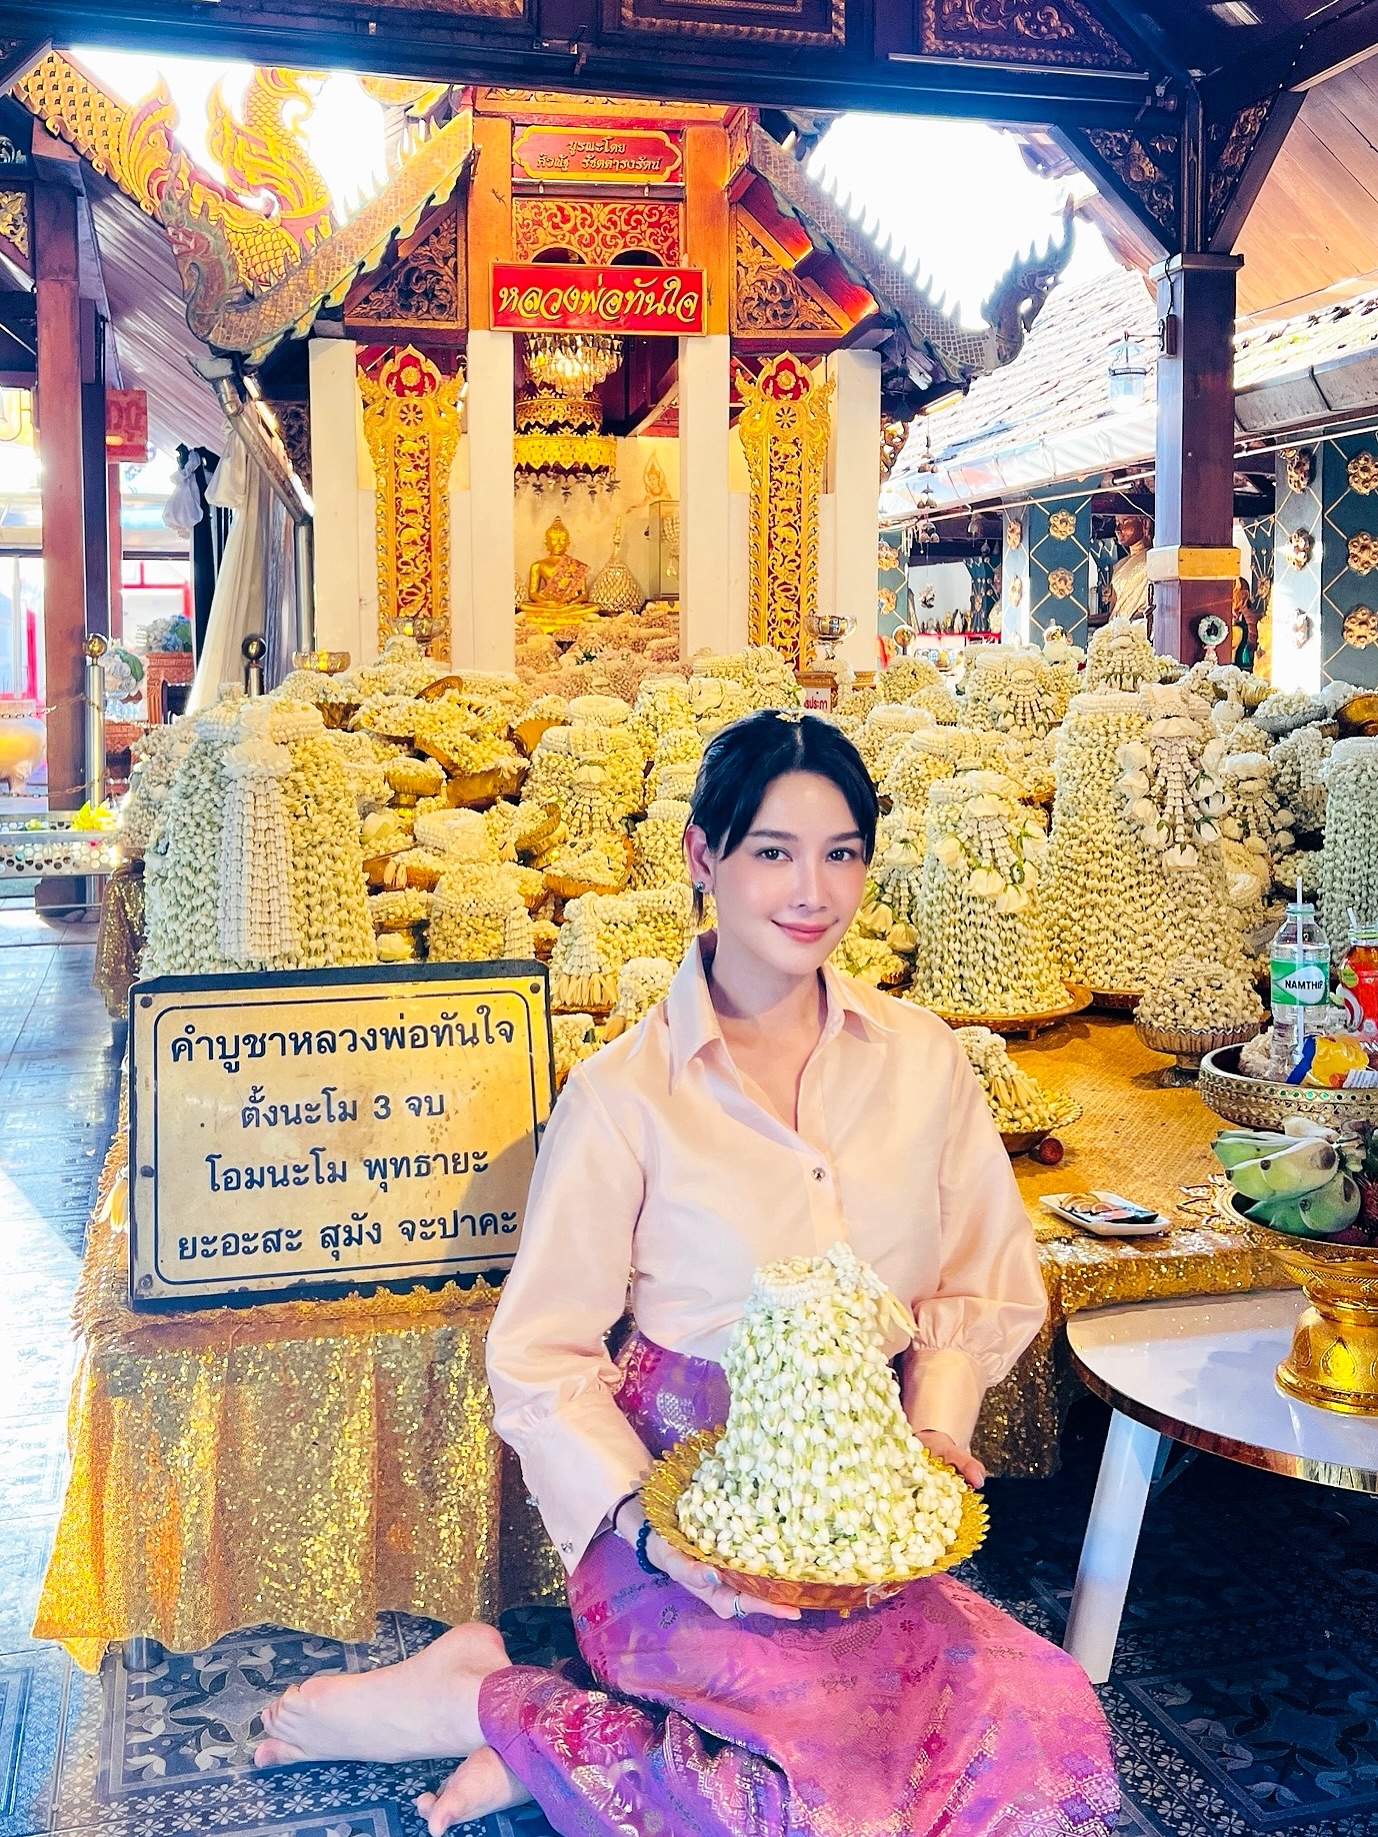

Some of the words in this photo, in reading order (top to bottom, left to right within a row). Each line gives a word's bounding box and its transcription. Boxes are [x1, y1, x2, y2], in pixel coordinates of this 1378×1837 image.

[498, 274, 698, 322] หลวงพ่อทันใจ
[170, 1004, 514, 1073] คำบูชาหลวงพ่อทันใจ
[241, 1085, 358, 1129] ตั้งนะโม
[373, 1095, 391, 1120] 3
[404, 1092, 445, 1118] จบ
[204, 1147, 347, 1193] โอมนะโม
[363, 1150, 489, 1193] พุทธายะ
[178, 1228, 303, 1260] ยะอะสะ
[319, 1212, 382, 1261] สุมัง
[398, 1209, 518, 1242] จะปาคะ
